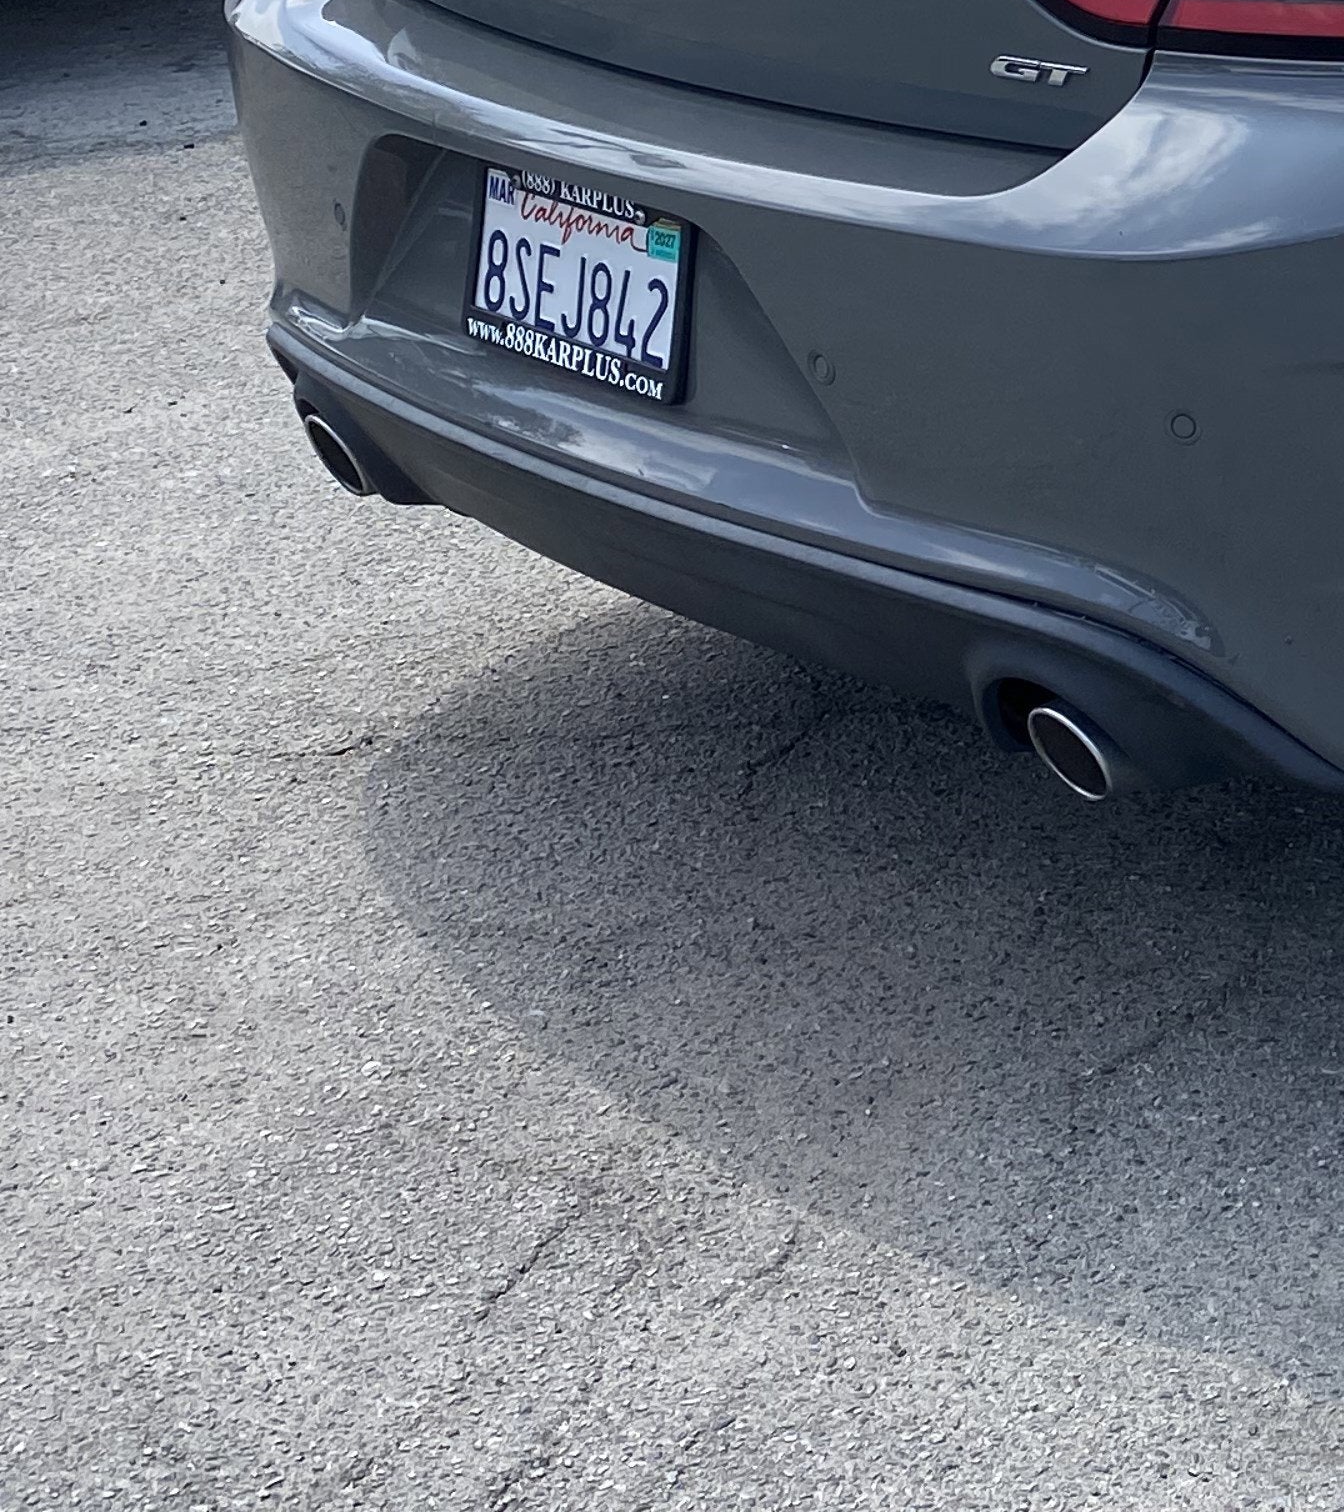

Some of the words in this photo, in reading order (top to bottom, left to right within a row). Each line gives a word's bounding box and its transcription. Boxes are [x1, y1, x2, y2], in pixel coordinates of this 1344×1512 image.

[990, 55, 1088, 86] GT
[489, 174, 516, 206] MAR
[559, 180, 635, 219] KARPLUS
[520, 191, 649, 253] California
[483, 229, 669, 368] 8SEJ842
